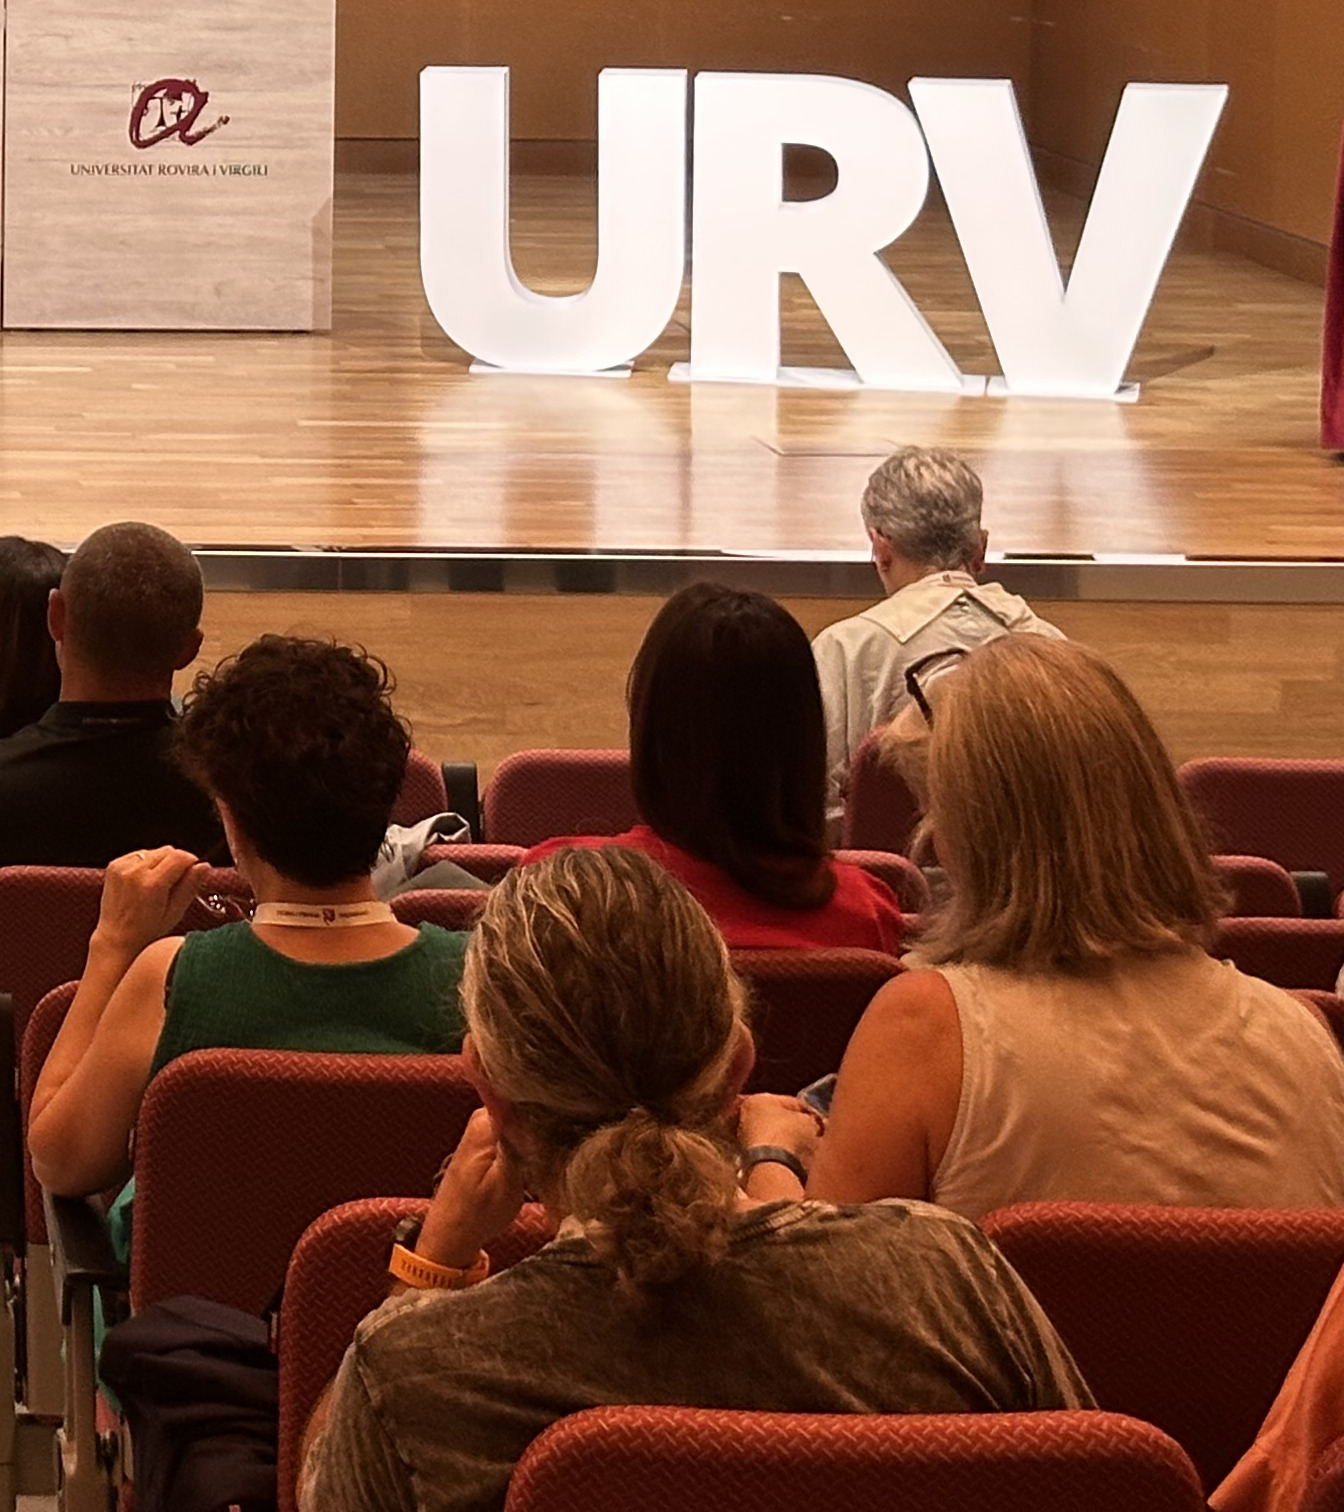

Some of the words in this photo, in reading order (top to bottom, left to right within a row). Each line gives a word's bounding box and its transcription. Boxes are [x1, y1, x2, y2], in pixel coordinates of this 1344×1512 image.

[70, 163, 154, 176] UNIVERSITAT
[157, 164, 210, 176] ROVIRA
[219, 164, 269, 177] VIRGILI
[418, 64, 1230, 396] URV
